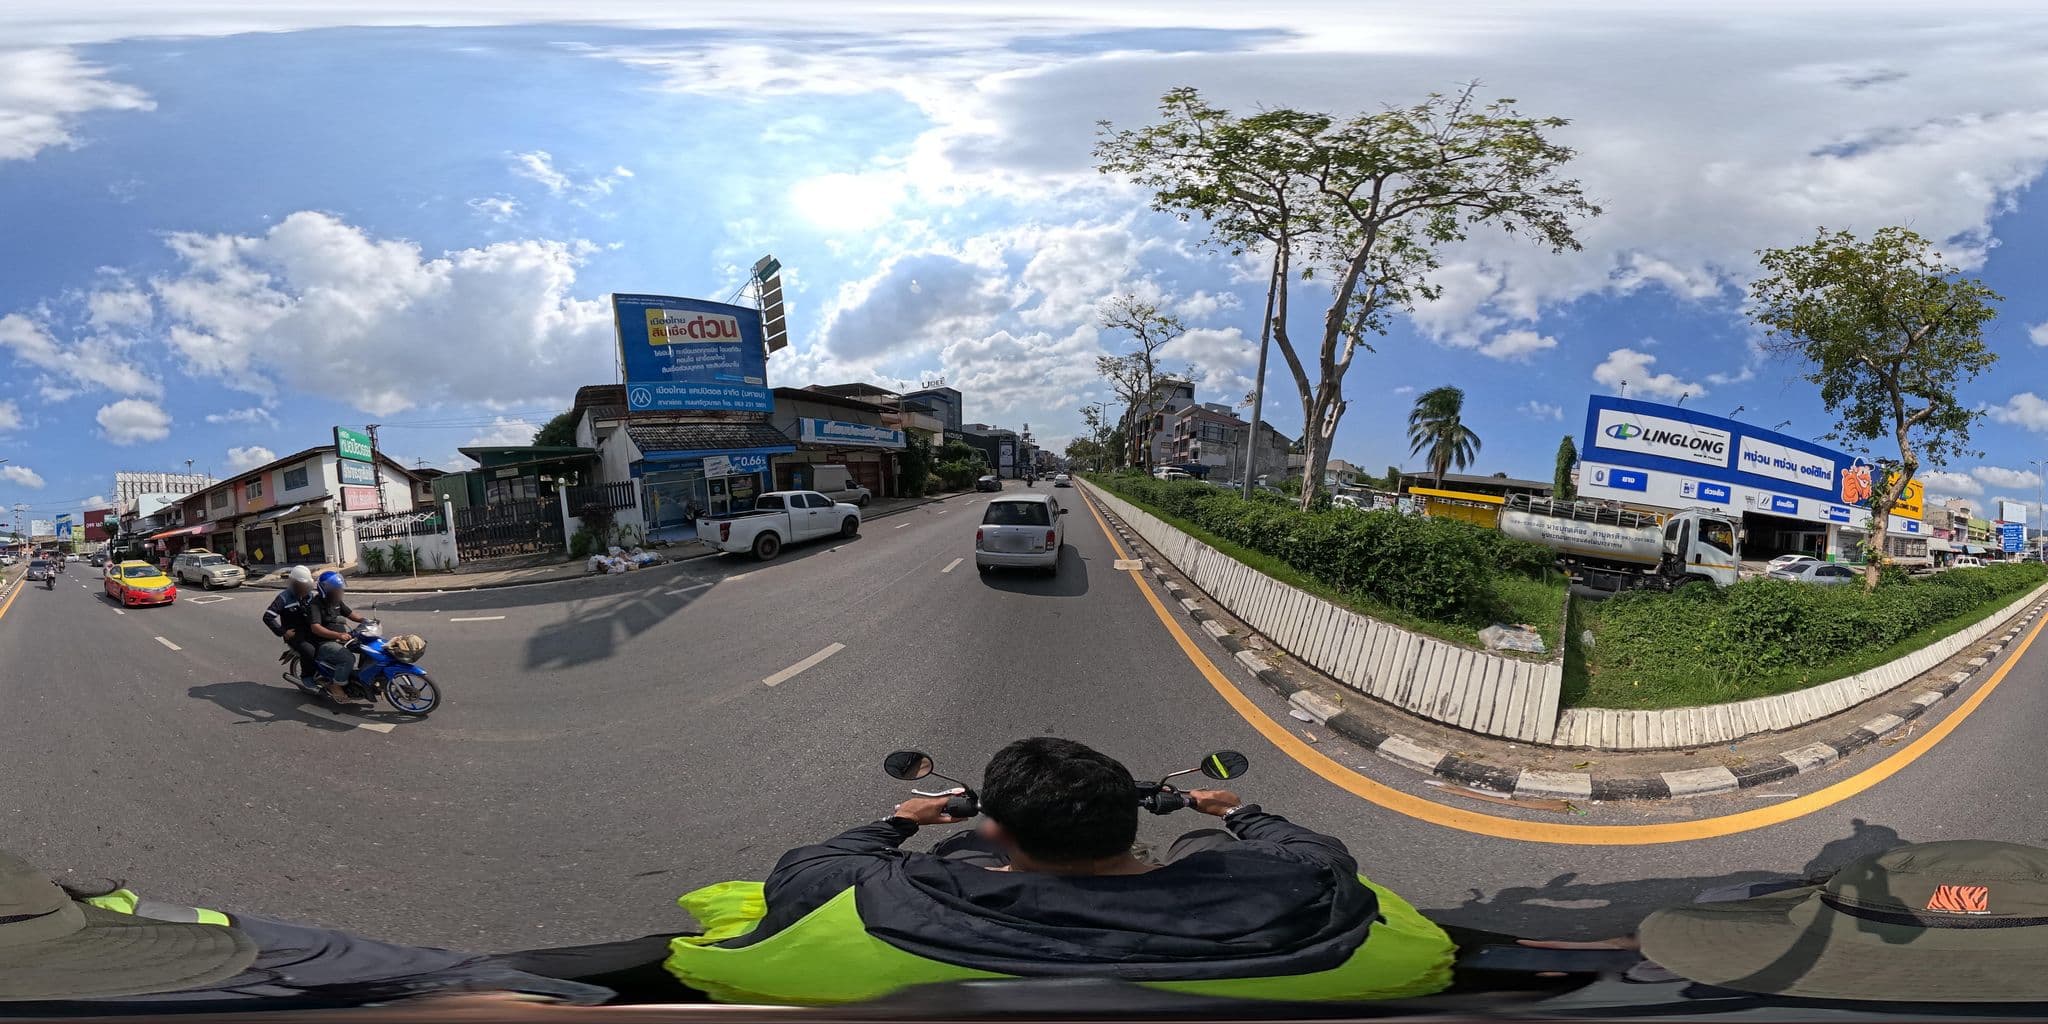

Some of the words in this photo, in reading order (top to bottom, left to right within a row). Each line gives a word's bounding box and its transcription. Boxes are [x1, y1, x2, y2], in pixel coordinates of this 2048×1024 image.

[687, 315, 738, 339] ด่วน
[656, 386, 686, 395] เมืองไทย
[723, 388, 740, 397] จำกัด
[741, 390, 766, 399] (มหาชน)
[1642, 428, 1724, 454] LINGLONG
